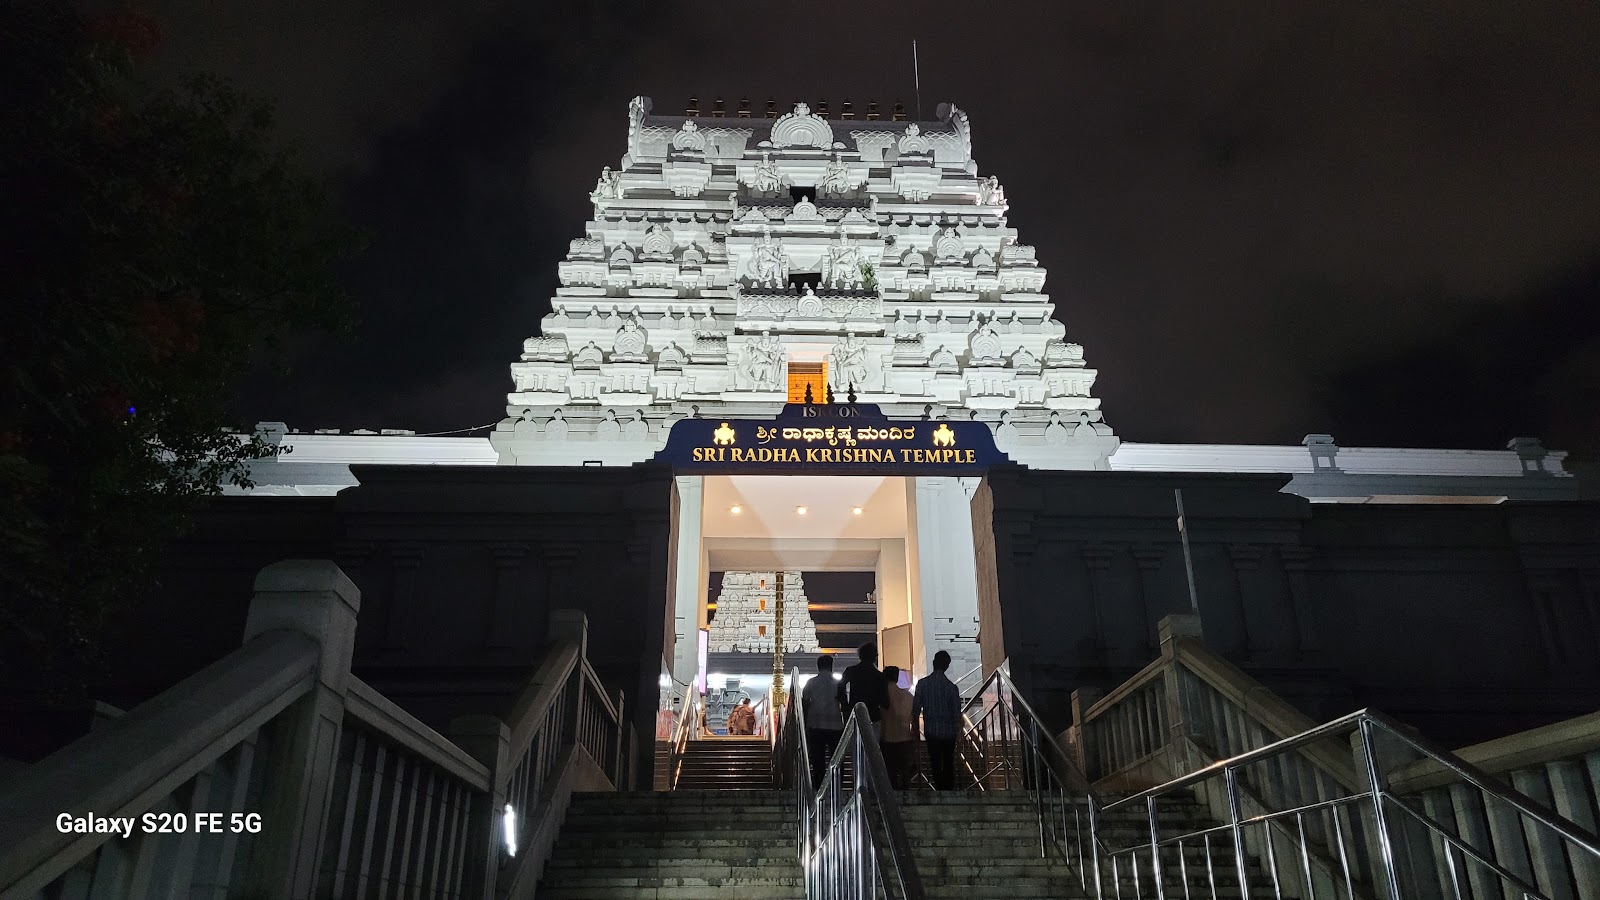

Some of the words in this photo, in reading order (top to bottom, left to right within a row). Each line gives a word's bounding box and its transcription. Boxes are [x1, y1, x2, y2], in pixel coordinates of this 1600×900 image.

[756, 425, 778, 445] ಶ್ರೀ
[782, 425, 857, 447] ರಾಧಾಕೃಷ್ಣ
[857, 425, 916, 440] ಮಂದಿರ
[692, 447, 726, 462] SRI
[730, 447, 802, 463] RADHA
[805, 447, 897, 463] KRISHNA
[900, 448, 977, 463] TEMPLE
